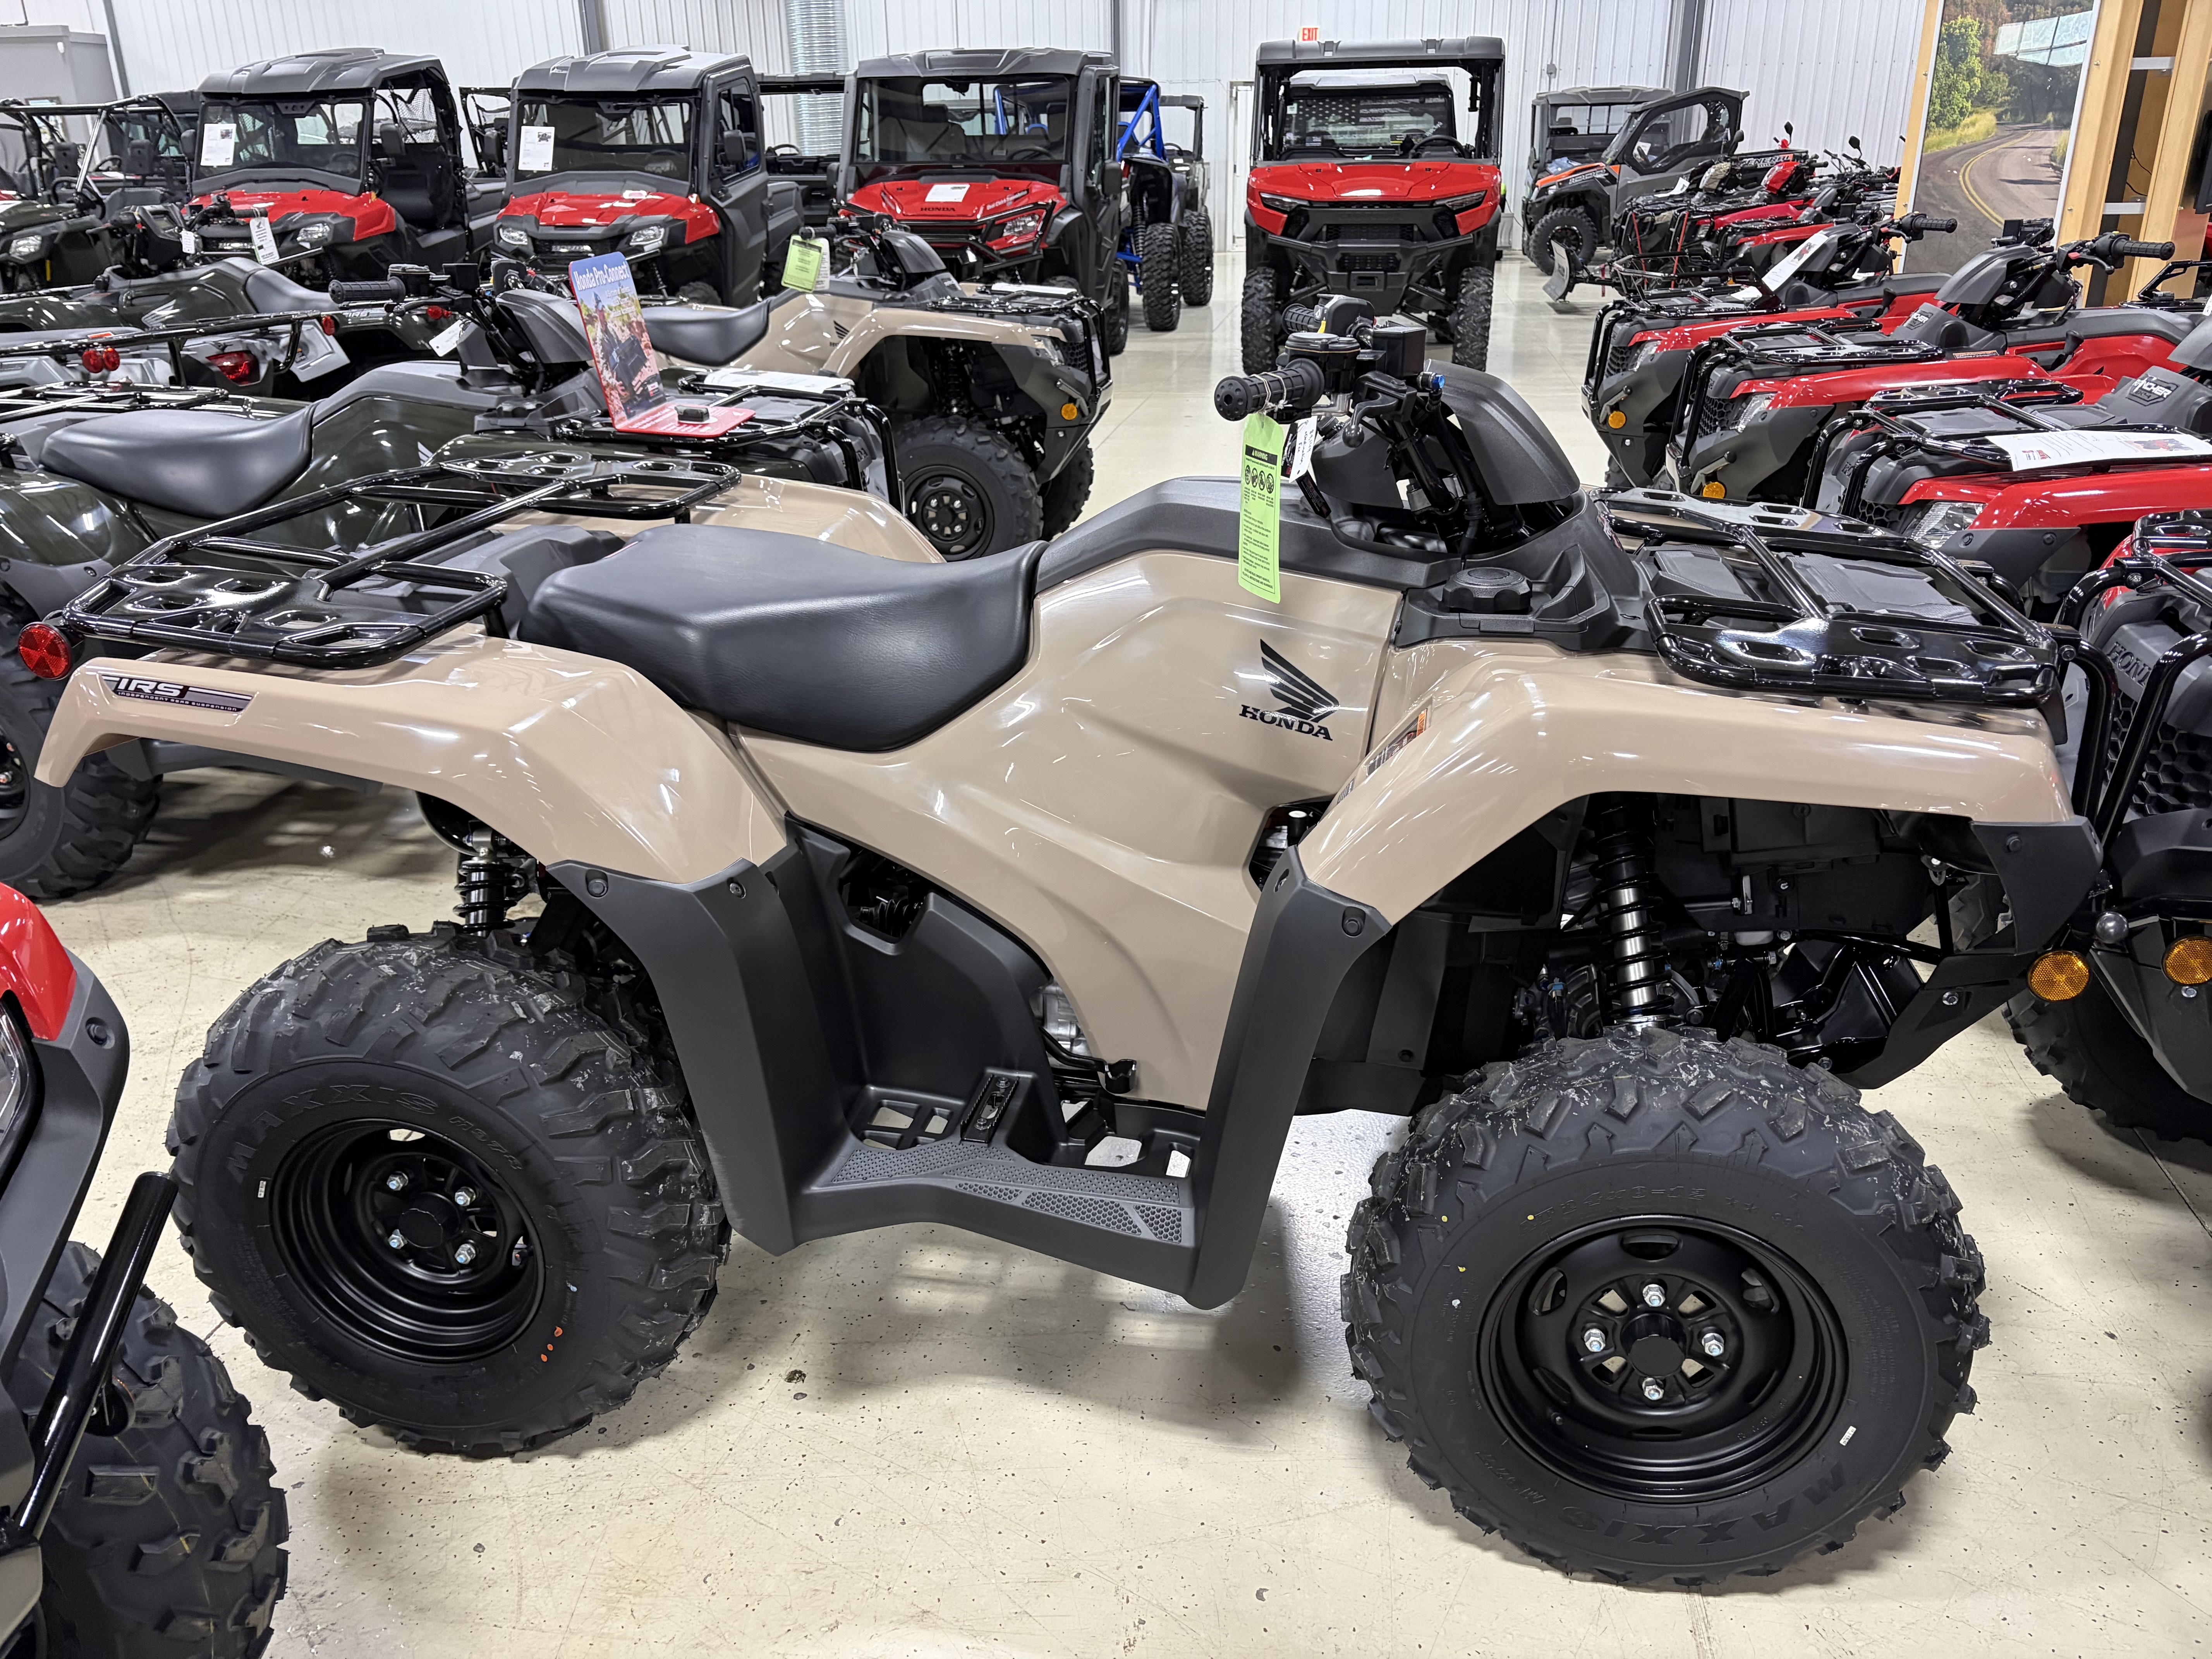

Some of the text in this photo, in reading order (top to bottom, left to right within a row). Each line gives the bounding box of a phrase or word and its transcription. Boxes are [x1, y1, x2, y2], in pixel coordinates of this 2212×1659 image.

[1302, 27, 1318, 41] EXIT
[573, 261, 630, 291] Honda Pro-Connect
[2132, 377, 2172, 398] RANCHER
[118, 678, 184, 697] IRS
[191, 702, 237, 711] SUSPENSION
[1239, 704, 1333, 741] HONDA
[227, 1084, 439, 1179] MAXXIS
[1558, 1463, 1846, 1545] MAXXIS
